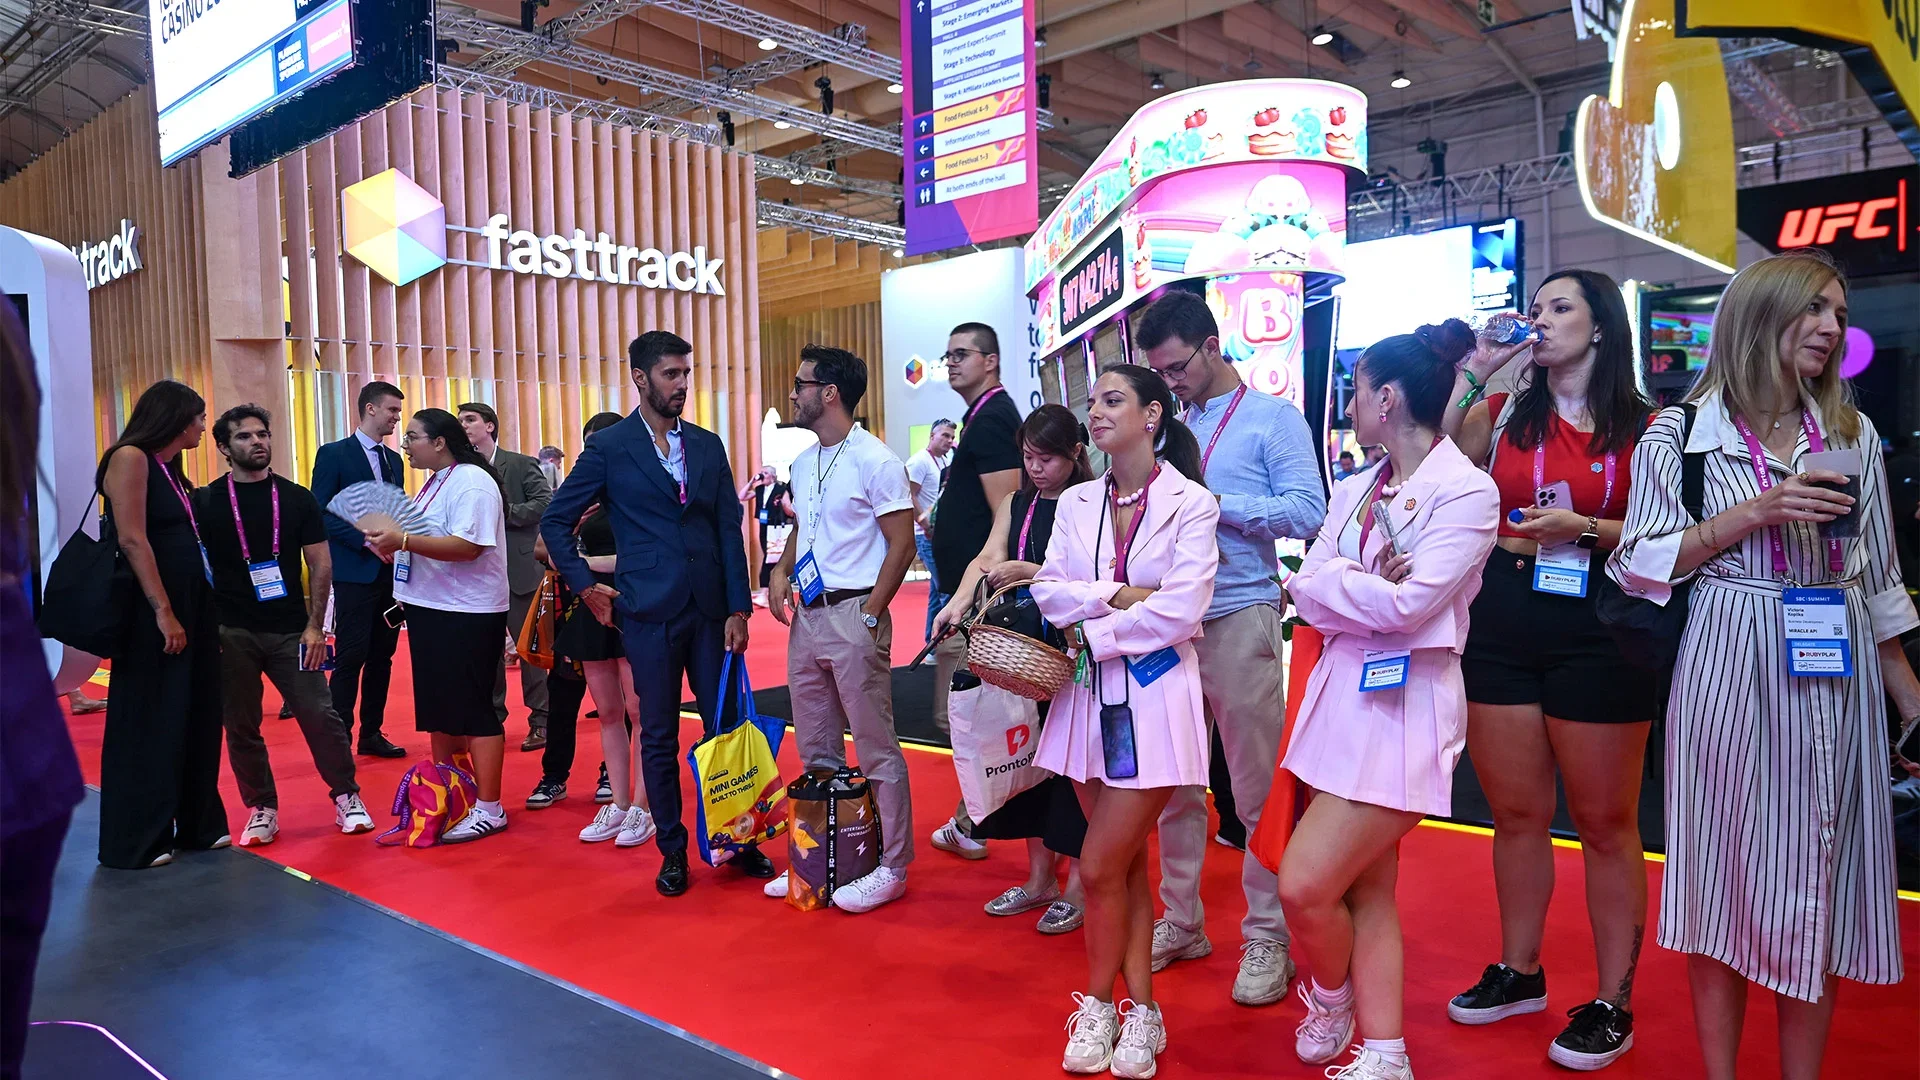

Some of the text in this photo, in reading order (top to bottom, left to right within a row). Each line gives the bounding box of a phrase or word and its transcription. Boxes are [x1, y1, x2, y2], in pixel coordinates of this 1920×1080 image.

[942, 17, 957, 27] Stage
[964, 6, 989, 20] Emerging
[943, 30, 1006, 56] Payment Expert Summit
[944, 60, 958, 70] Stage
[964, 48, 996, 62] Technology
[944, 91, 958, 100] Stage
[963, 82, 982, 93] Affiliate
[982, 78, 1001, 88] Leaders
[1002, 72, 1020, 82] Summit
[944, 114, 957, 123] Food
[958, 109, 978, 119] Festival
[945, 129, 990, 146] Information Point
[946, 161, 958, 170] Food
[959, 157, 978, 167] Festival
[952, 183, 964, 192] both
[965, 180, 977, 188] ends
[985, 176, 993, 184] the
[994, 173, 1005, 181] hall
[1778, 197, 1898, 248] UFC
[481, 213, 726, 296] fasttrack
[1756, 455, 1768, 487] Ortak.me
[710, 780, 729, 796] MINI
[731, 766, 759, 786] GAMES
[712, 782, 755, 804] BUILT TO THRILL
[394, 781, 408, 813] Uplatform
